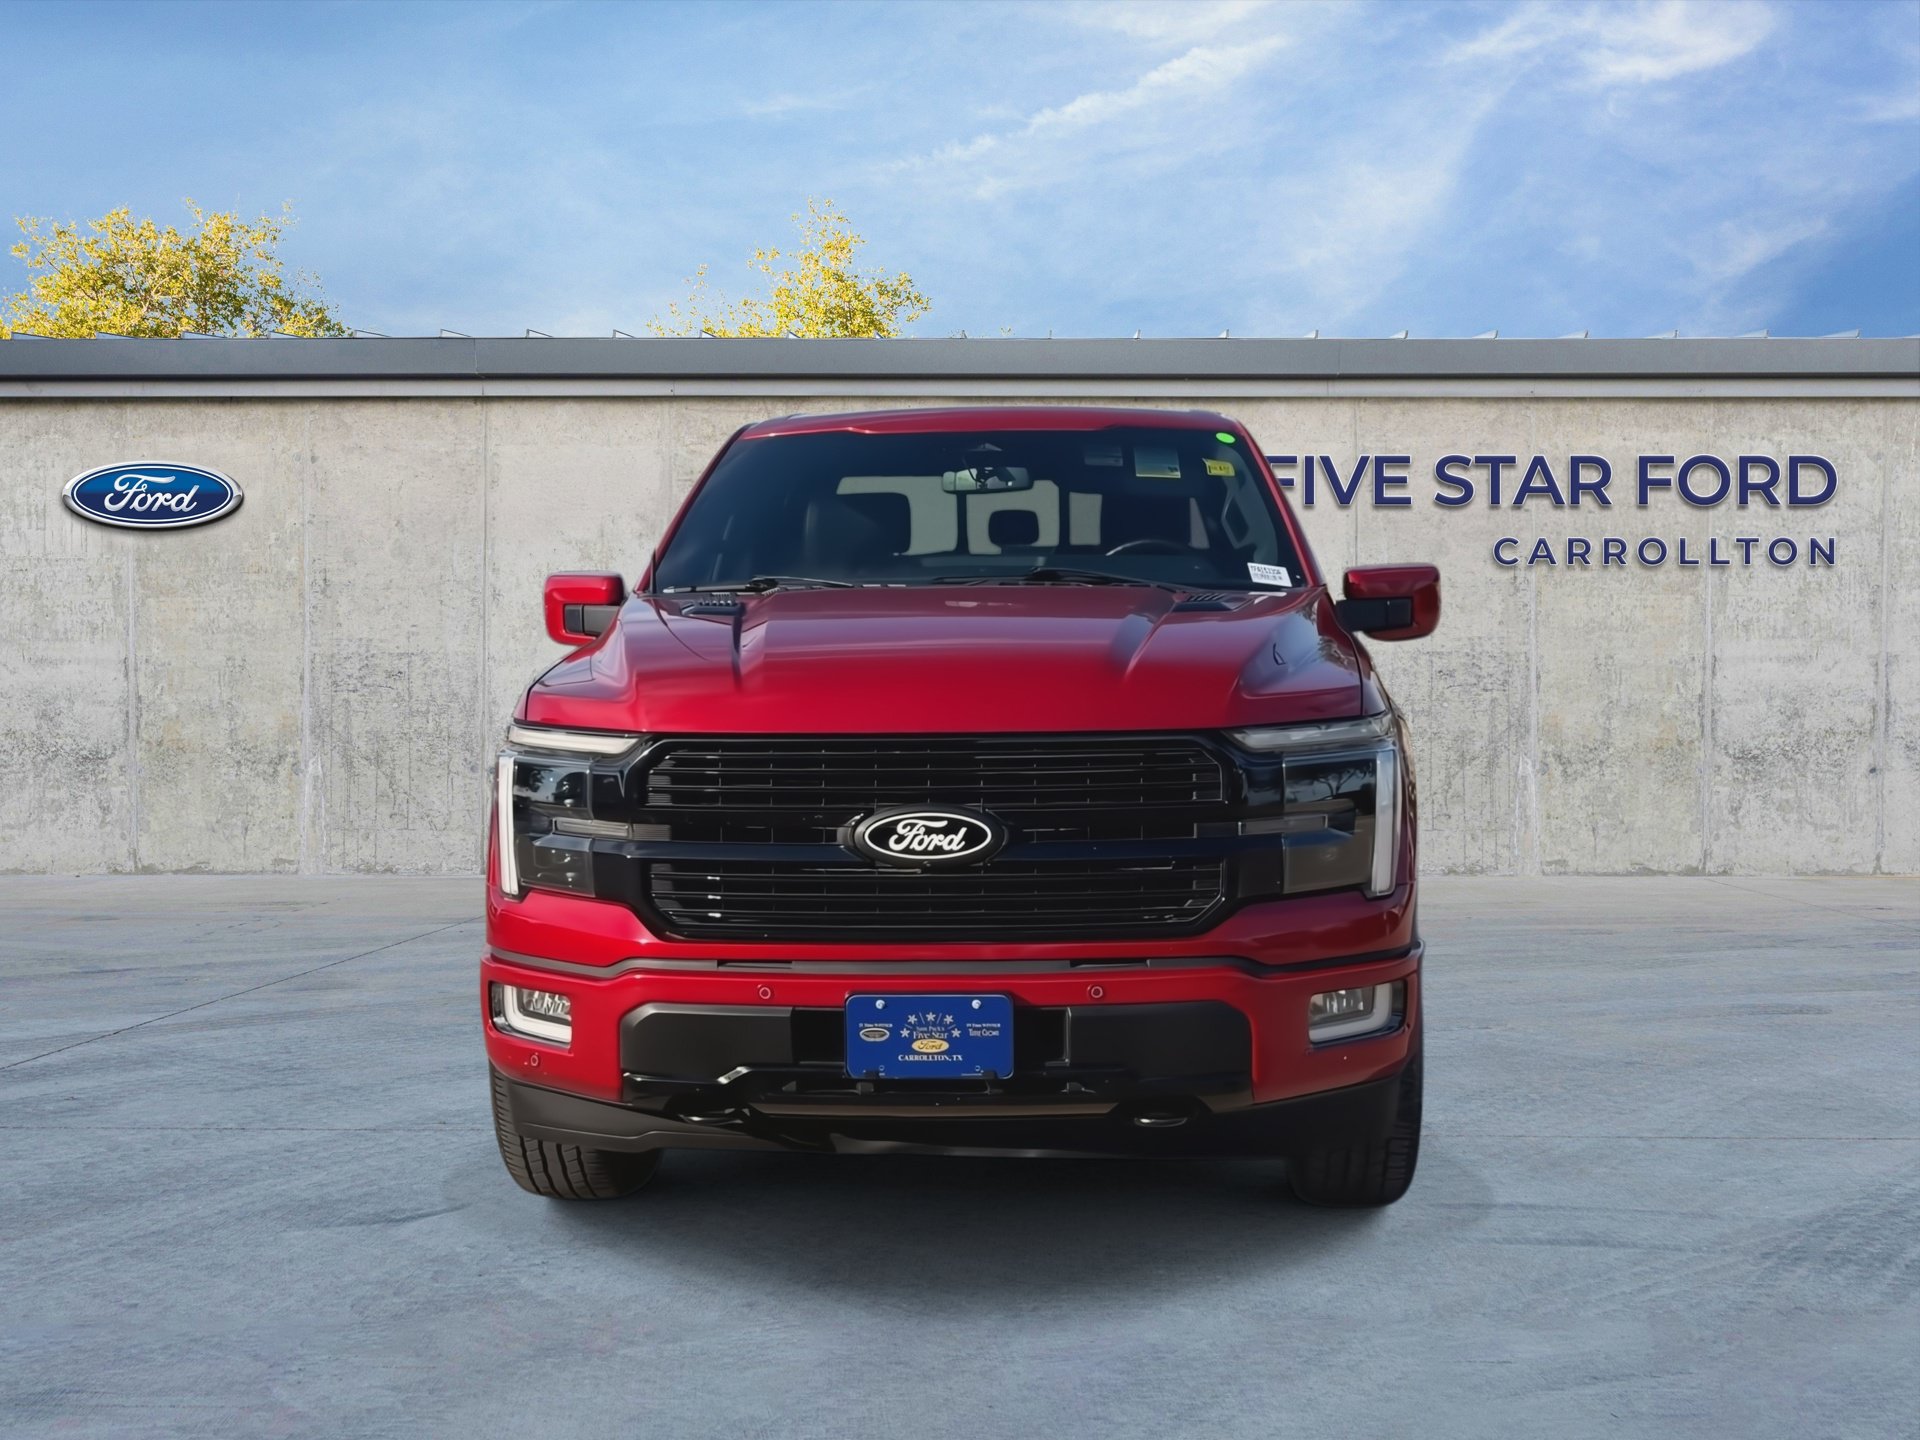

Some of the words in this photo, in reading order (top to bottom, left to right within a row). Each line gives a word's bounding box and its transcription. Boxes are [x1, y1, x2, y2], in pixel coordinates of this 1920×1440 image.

[104, 473, 200, 513] Ford
[1434, 454, 1613, 507] STAR
[1637, 454, 1838, 507] FORD
[1493, 536, 1836, 566] CARROLLTON
[888, 818, 968, 851] Ford
[913, 1031, 930, 1039] Five
[931, 1031, 949, 1039] Star
[917, 1040, 944, 1050] Ford
[898, 1054, 952, 1062] CARROLLTON,
[952, 1054, 963, 1062] TX
